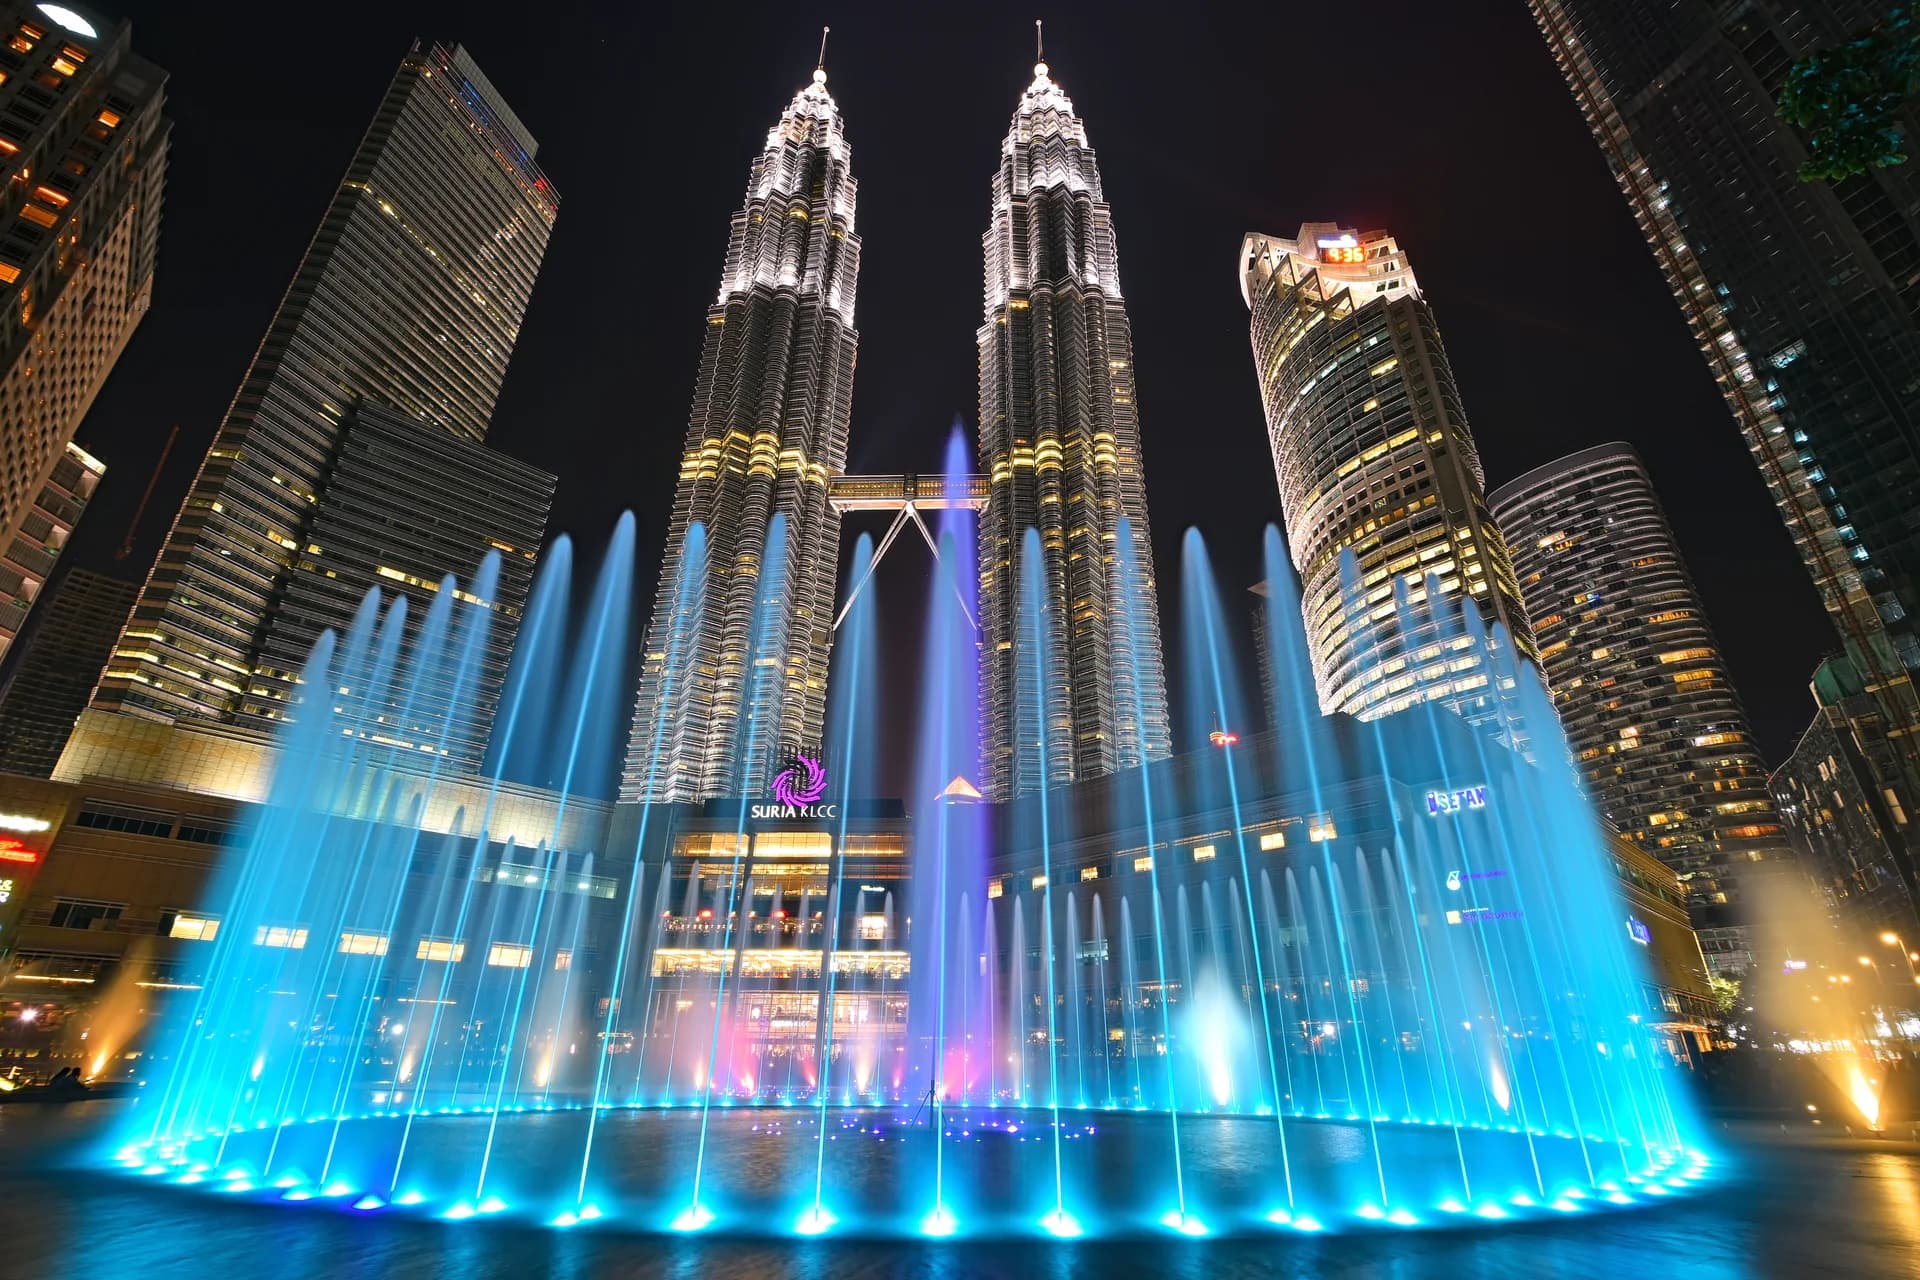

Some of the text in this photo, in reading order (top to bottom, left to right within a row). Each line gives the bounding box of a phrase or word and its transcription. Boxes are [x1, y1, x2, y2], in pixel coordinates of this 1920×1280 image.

[1328, 248, 1364, 262] 9:36
[752, 805, 837, 818] SURIA KLCC
